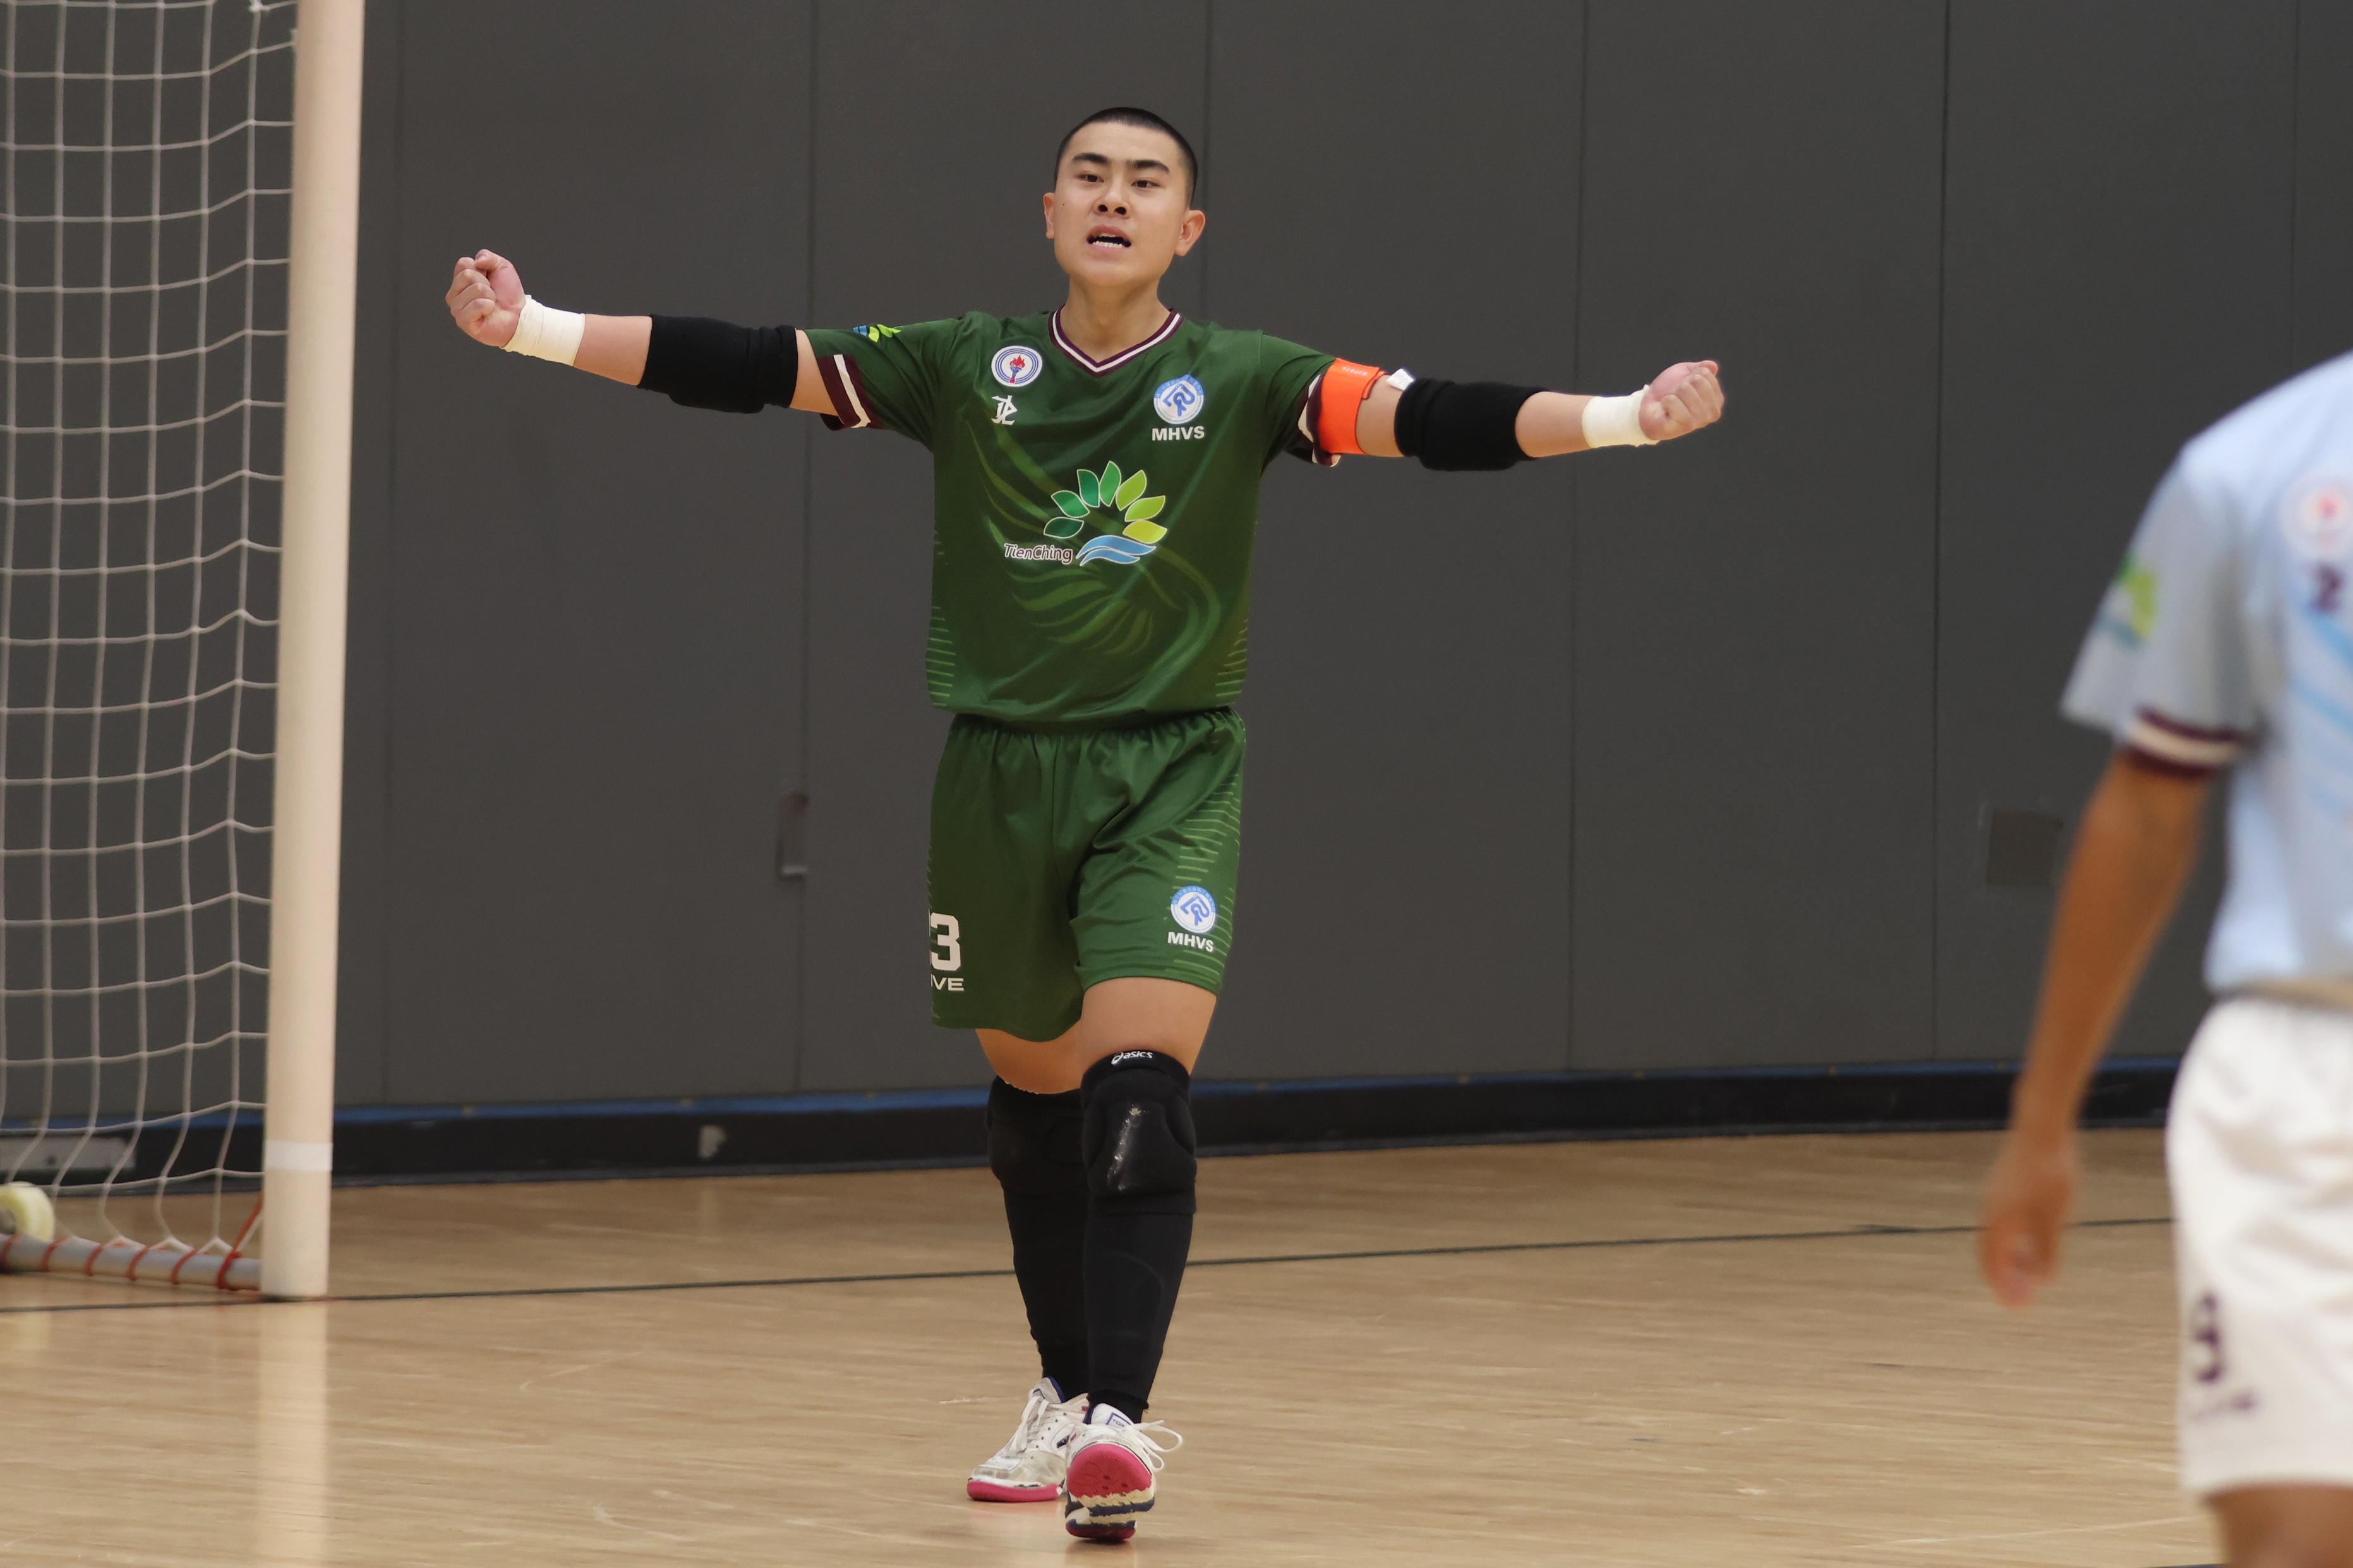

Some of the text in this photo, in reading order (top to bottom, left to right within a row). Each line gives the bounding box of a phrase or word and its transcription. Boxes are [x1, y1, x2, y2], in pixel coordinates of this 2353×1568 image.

[1342, 366, 1368, 376] KIPSTA
[1152, 426, 1205, 441] MHVS
[1004, 543, 1073, 565] TienChing
[928, 907, 961, 971] 3
[1167, 931, 1213, 952] MHVS
